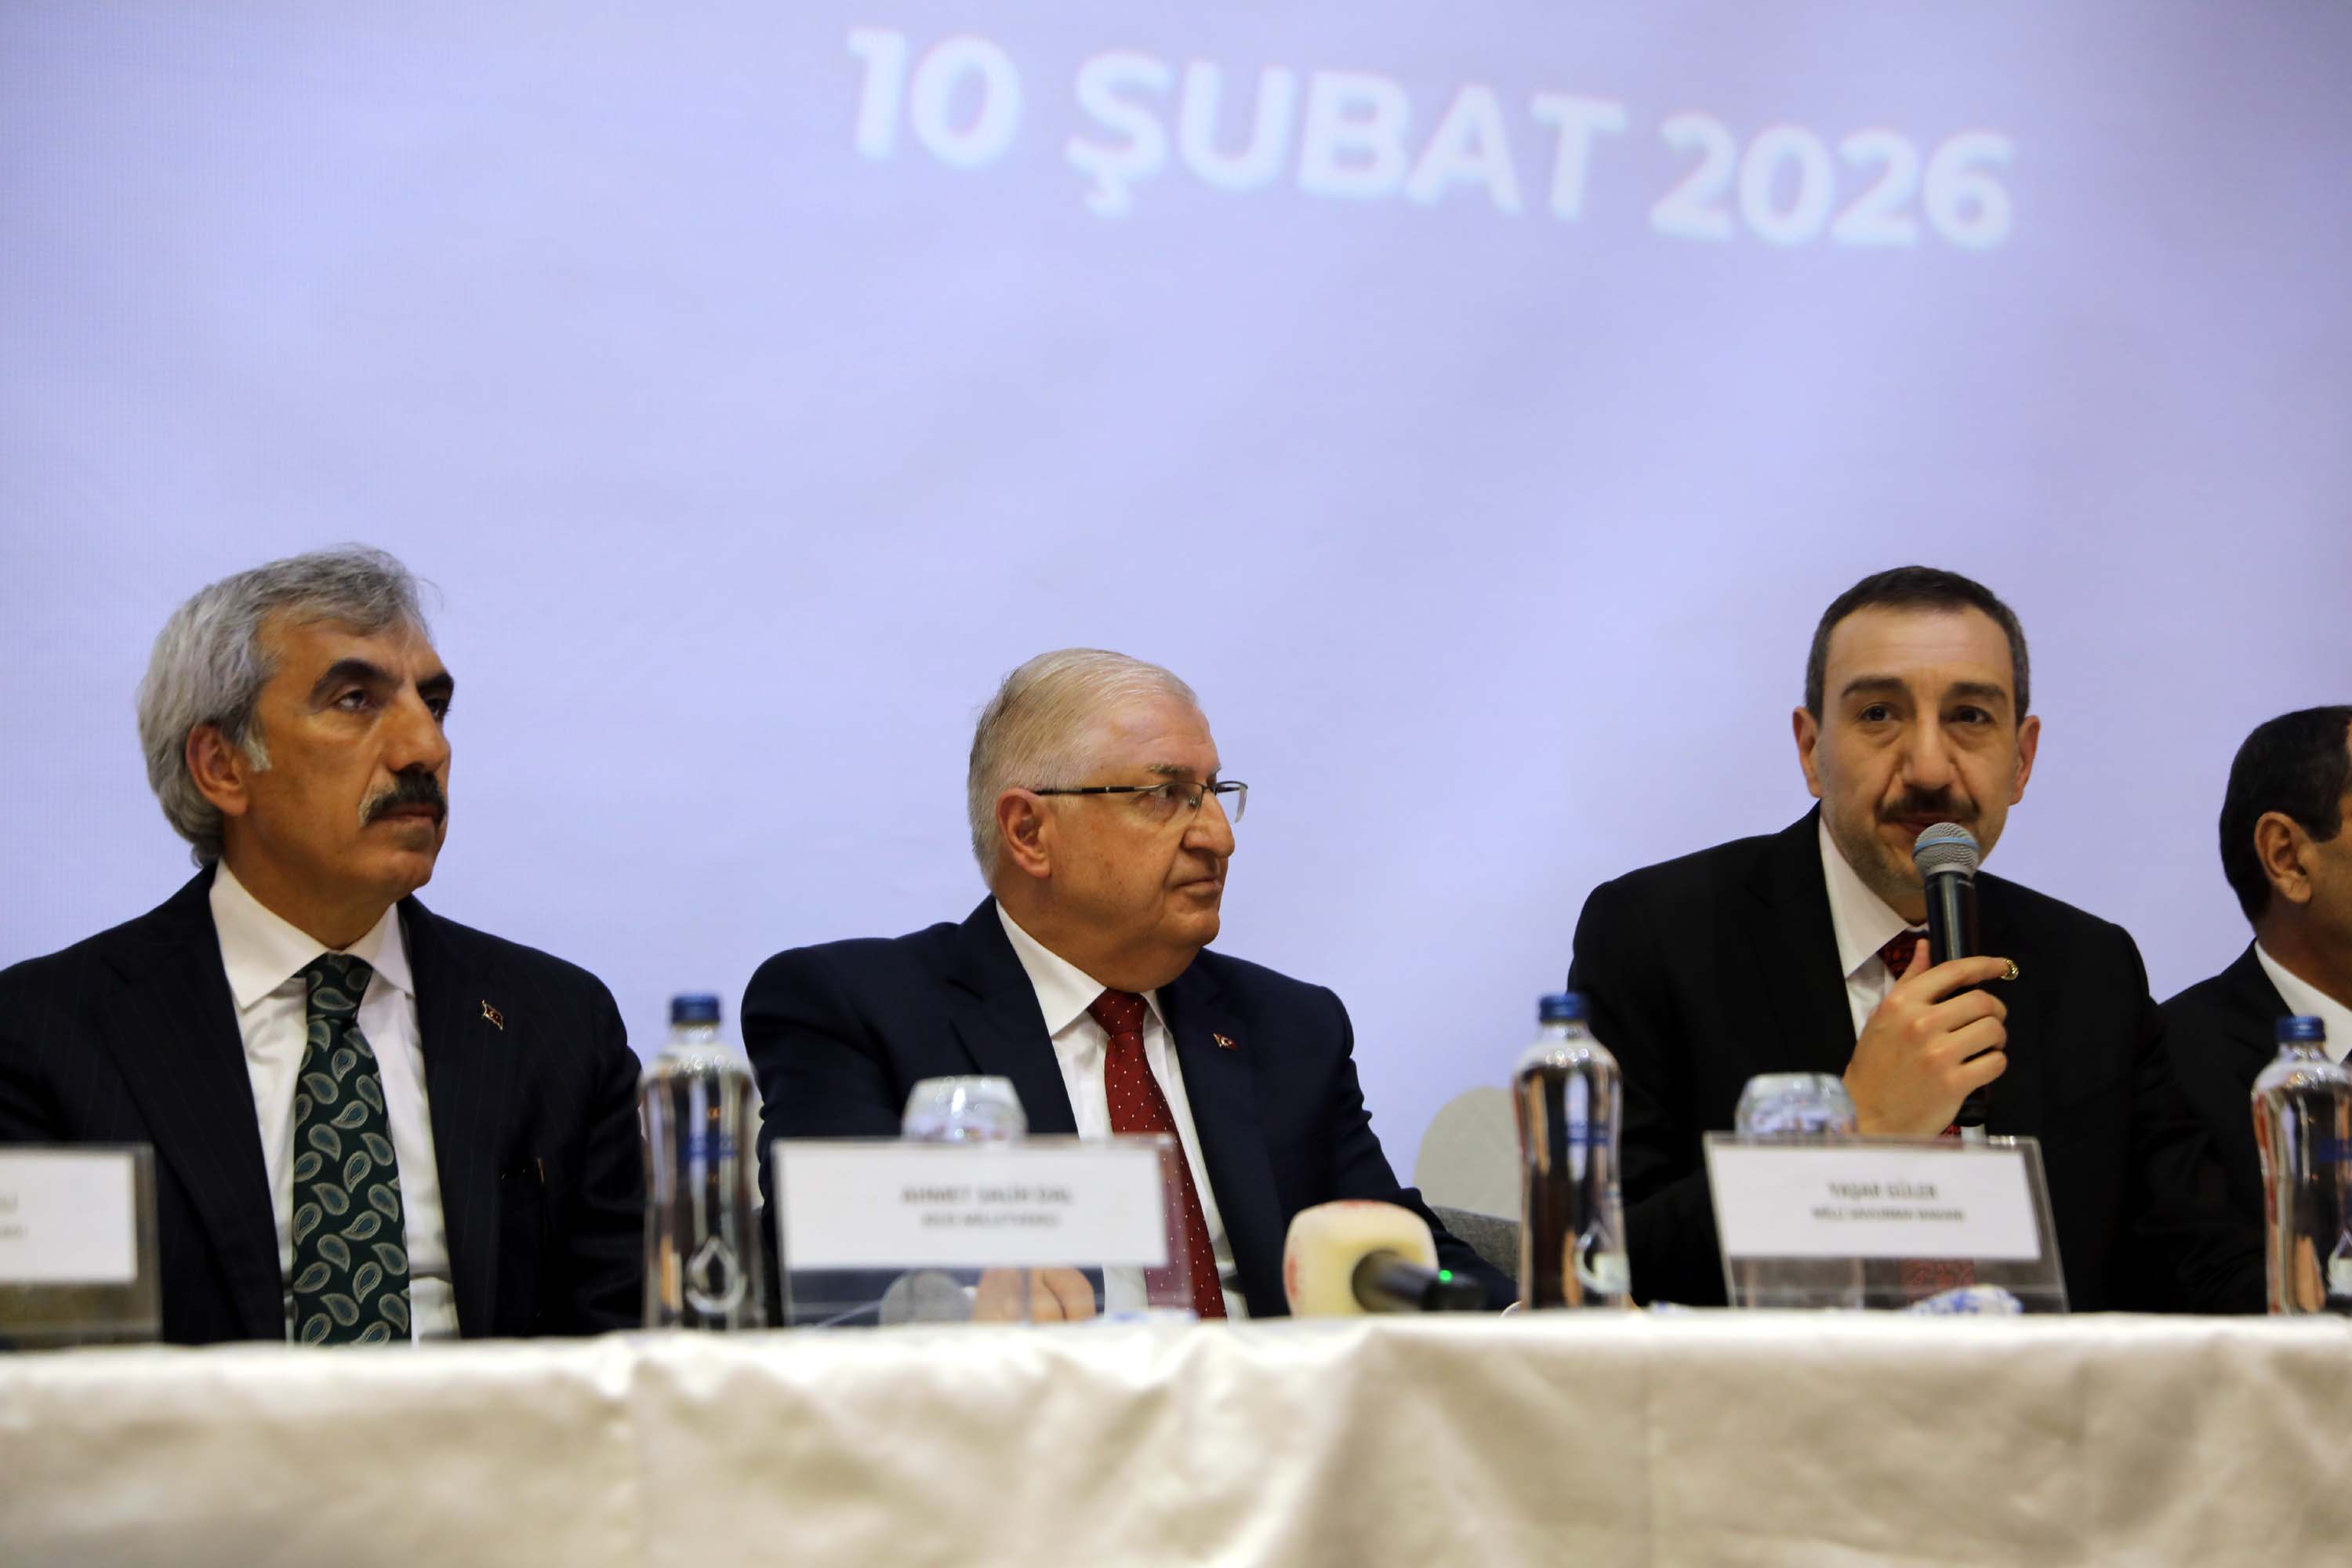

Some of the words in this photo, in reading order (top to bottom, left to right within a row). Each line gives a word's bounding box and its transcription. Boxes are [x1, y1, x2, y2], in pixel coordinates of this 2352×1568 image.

[848, 26, 1018, 165] 10
[1064, 49, 1625, 218] ŞUBAT
[1650, 111, 2013, 245] 2026
